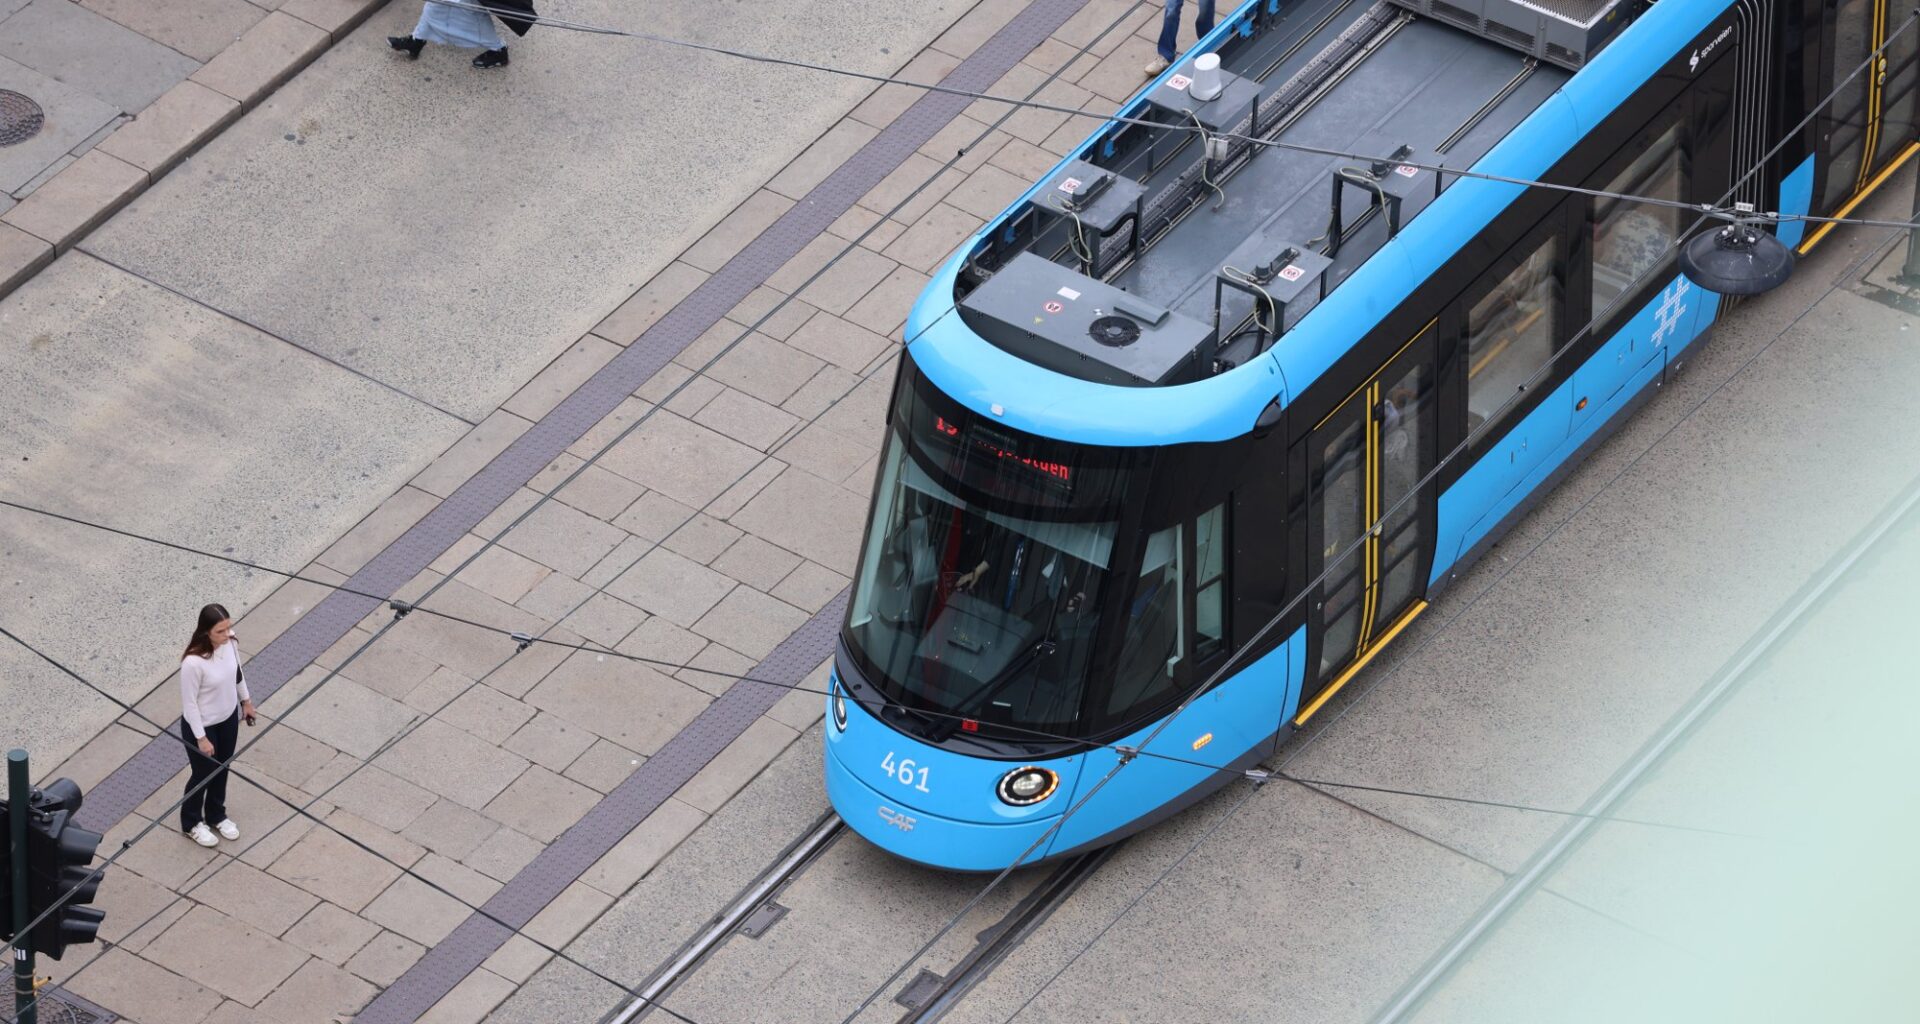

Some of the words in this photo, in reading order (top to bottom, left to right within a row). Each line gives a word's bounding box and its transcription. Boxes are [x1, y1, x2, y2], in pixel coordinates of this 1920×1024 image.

[1701, 26, 1732, 58] sporveien
[880, 751, 930, 793] 461
[878, 806, 916, 831] CAF
